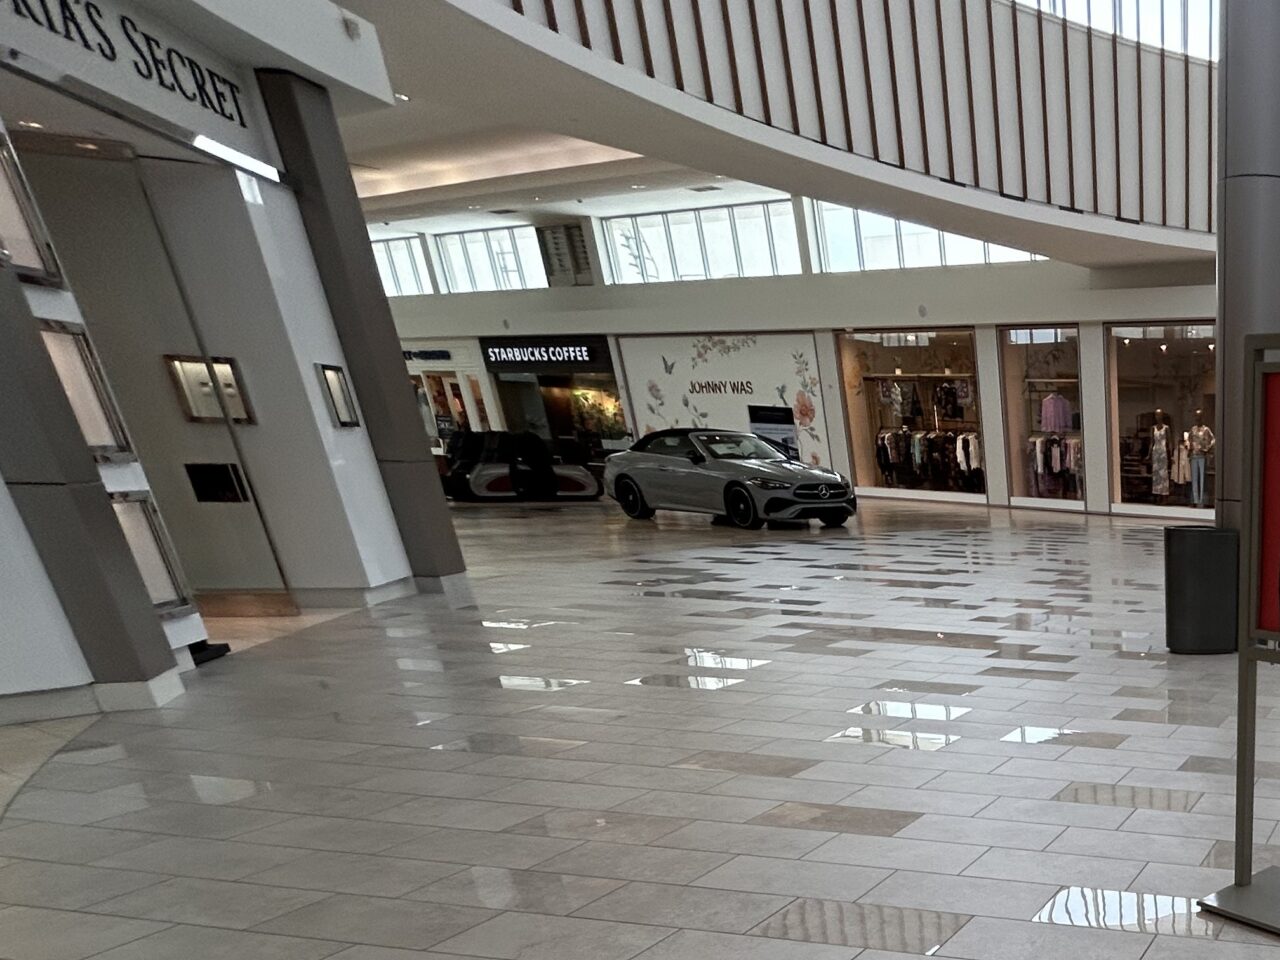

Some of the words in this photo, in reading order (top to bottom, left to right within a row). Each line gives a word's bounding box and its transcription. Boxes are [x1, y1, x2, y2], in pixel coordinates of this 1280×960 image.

[119, 15, 248, 128] SECRET
[487, 346, 548, 362] STARBUCKS
[549, 346, 590, 361] COFFEE
[688, 380, 728, 394] JOHNNY
[729, 380, 753, 395] WAS
